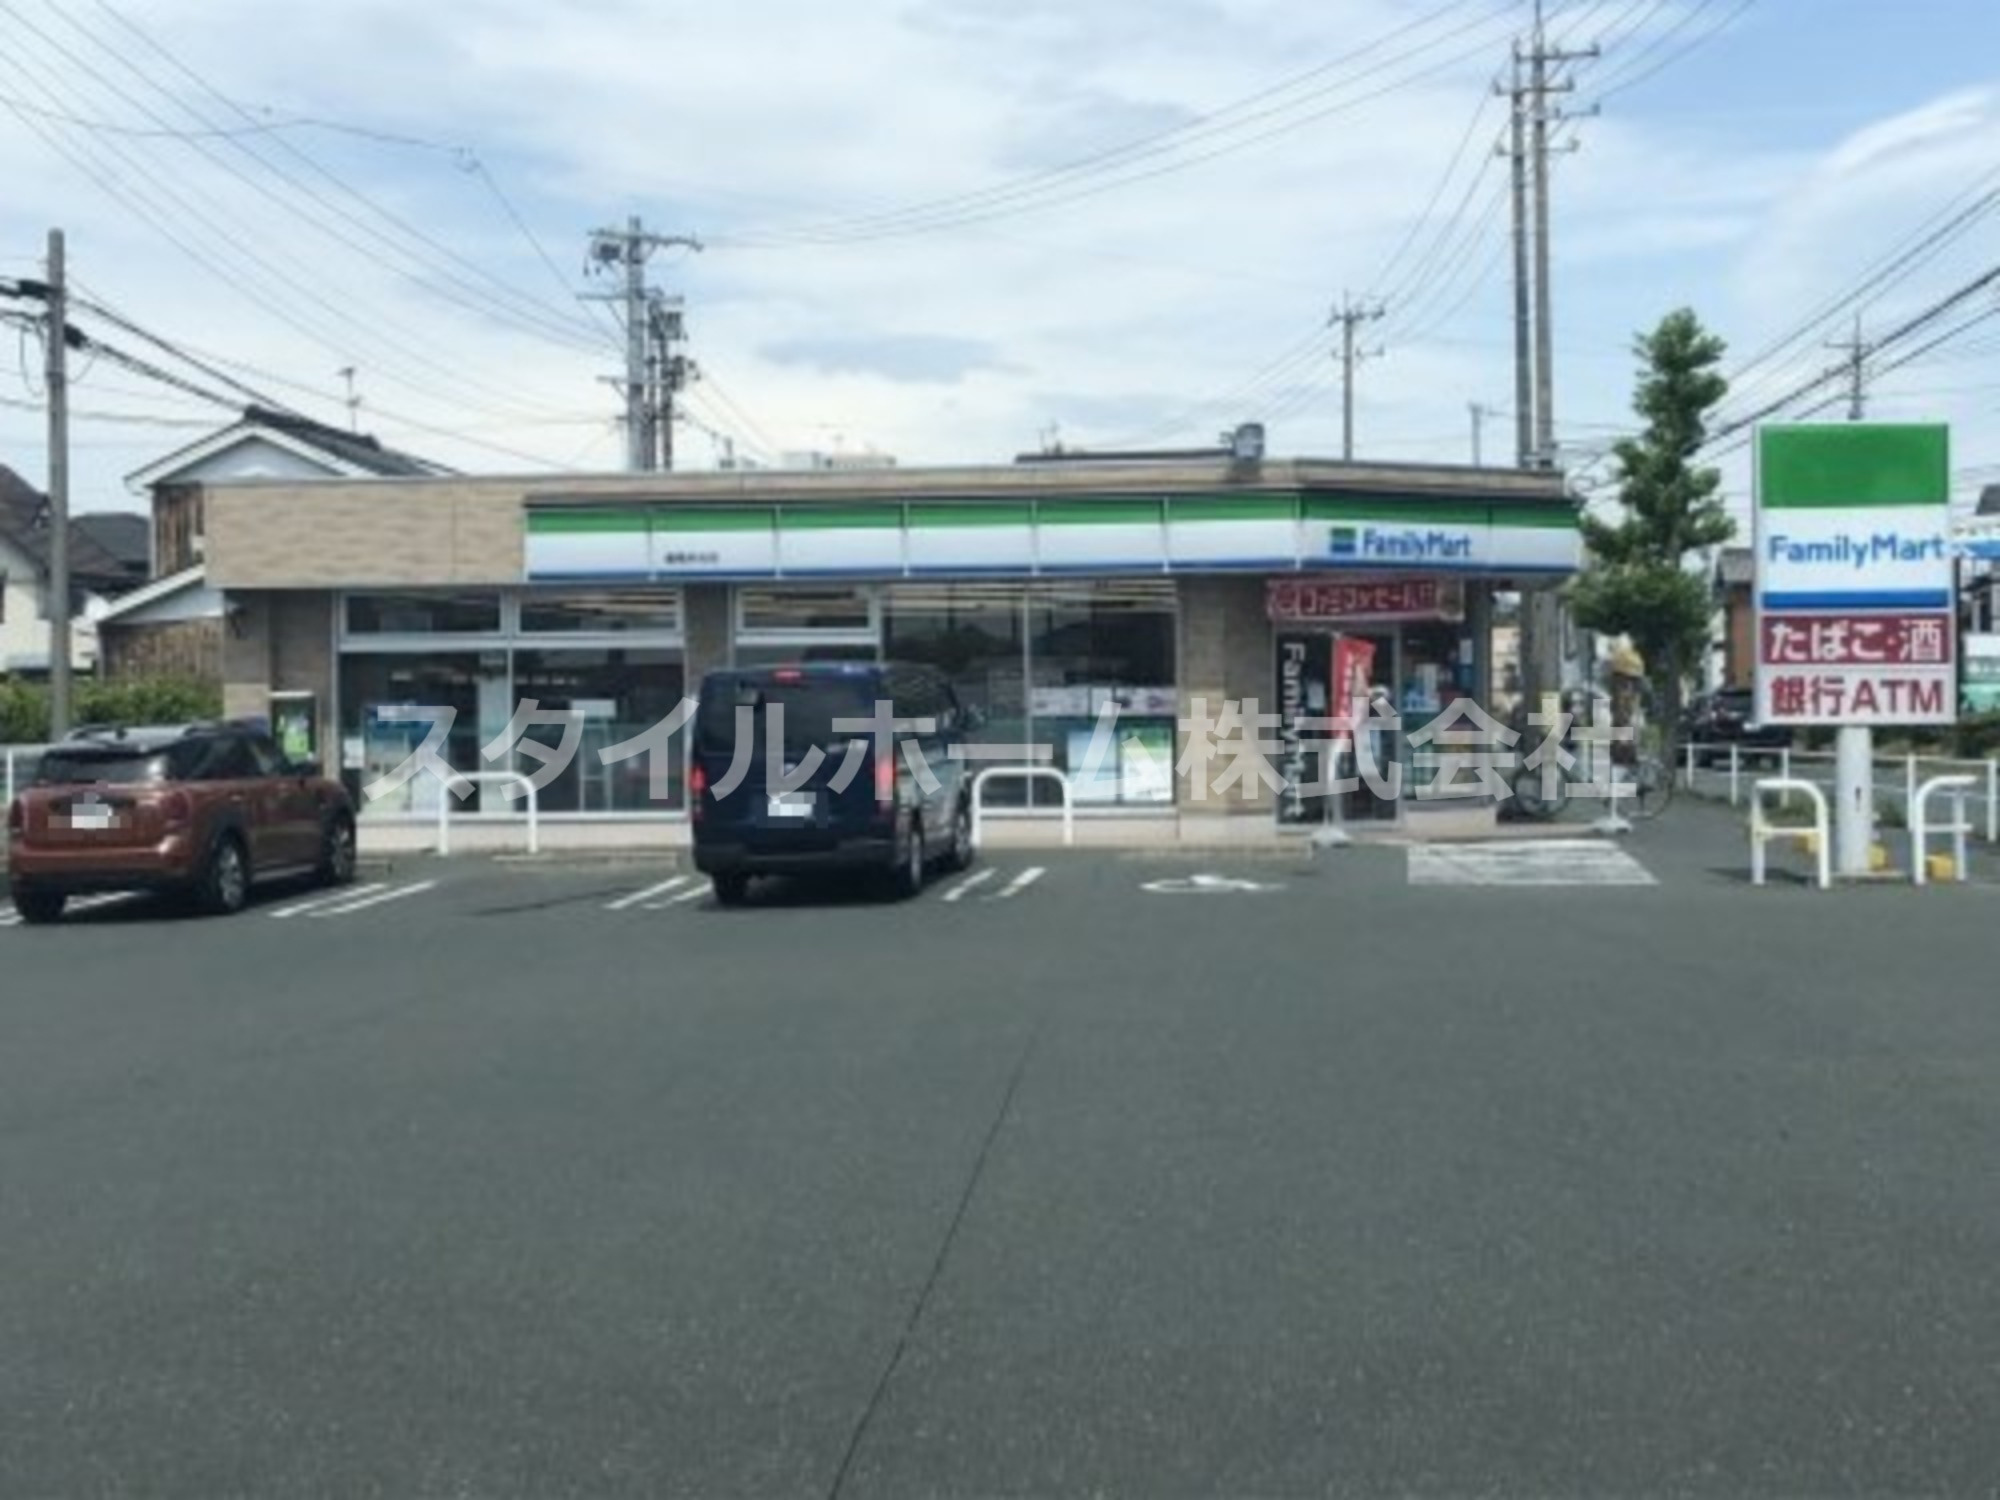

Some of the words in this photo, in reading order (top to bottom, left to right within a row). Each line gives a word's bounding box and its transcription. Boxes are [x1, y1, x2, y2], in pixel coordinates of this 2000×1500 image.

[1363, 527, 1471, 560] FamilyMart
[1767, 532, 1946, 568] FamilyMart
[1770, 618, 1943, 661] たばこ・酒
[1770, 675, 1944, 717] 銀行ATM
